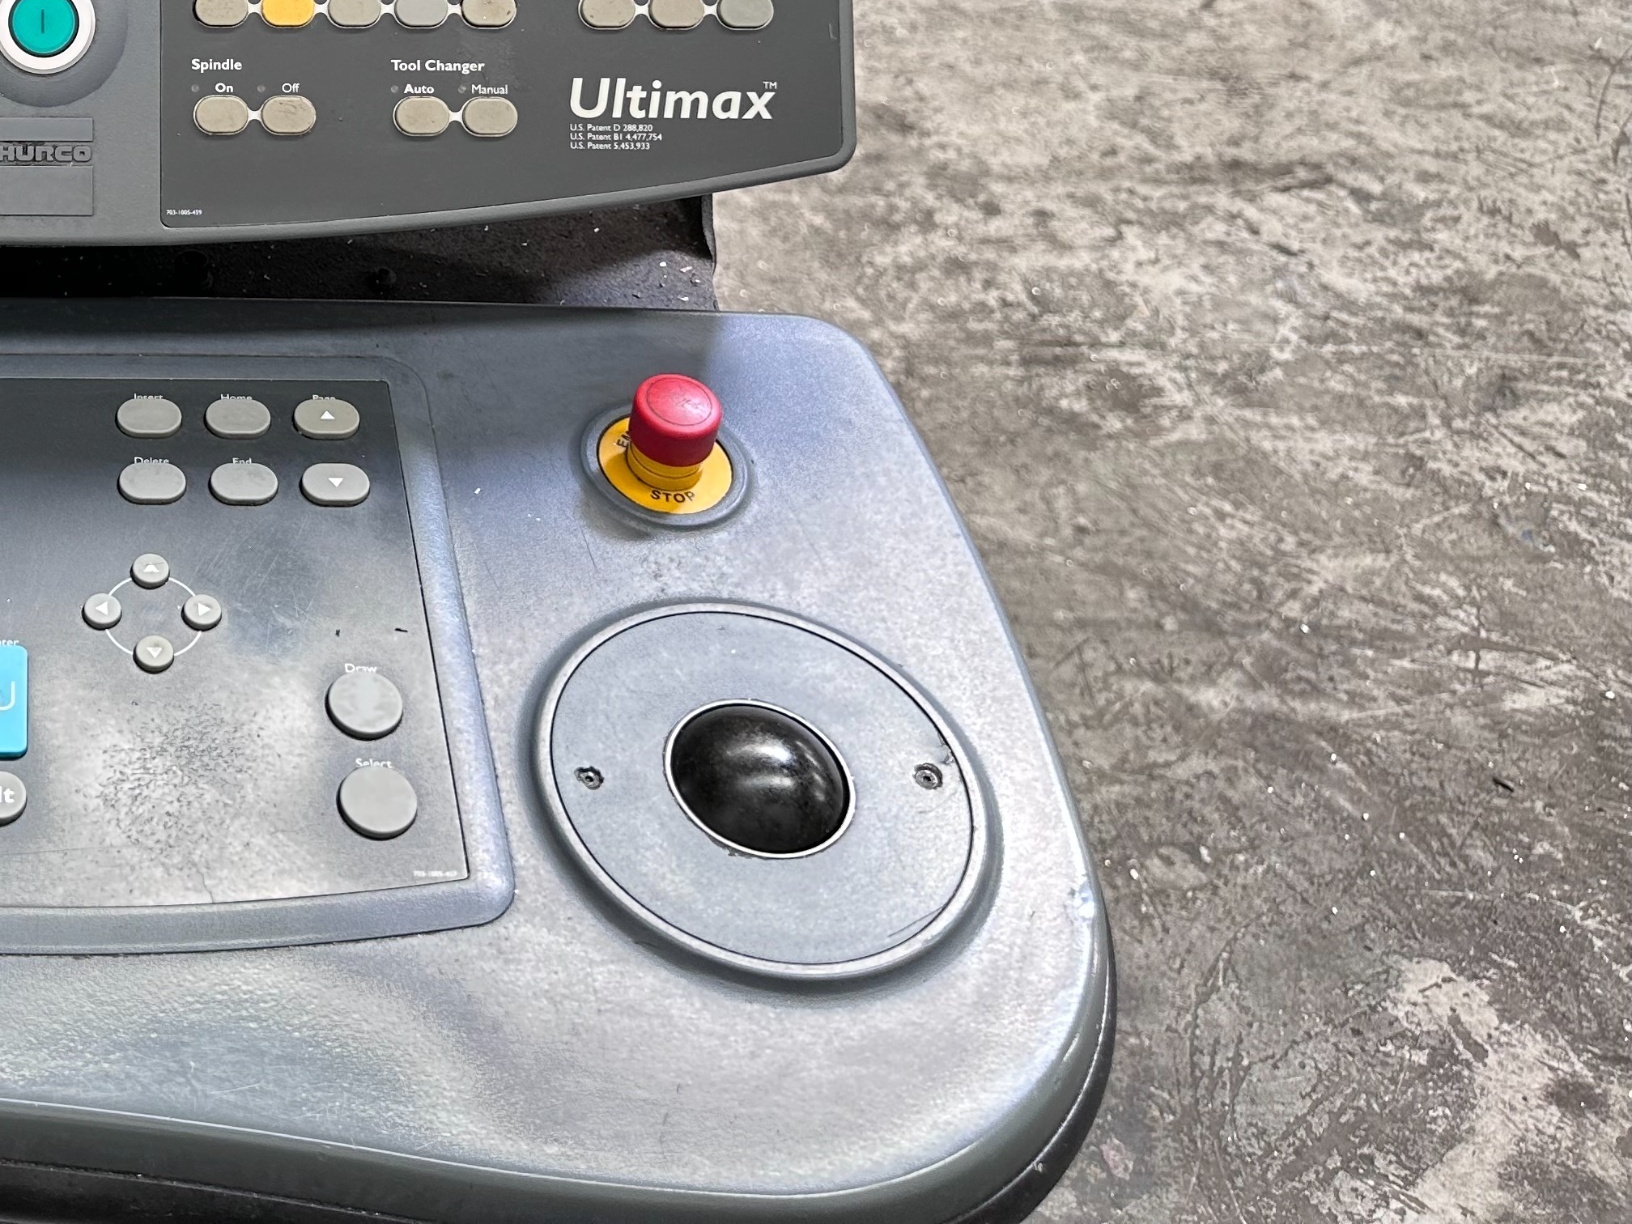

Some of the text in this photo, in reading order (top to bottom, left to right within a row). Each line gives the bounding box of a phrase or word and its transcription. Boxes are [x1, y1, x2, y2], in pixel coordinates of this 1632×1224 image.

[191, 58, 242, 73] Spindle
[390, 59, 485, 74] Tool Changer
[214, 82, 233, 92] On
[281, 82, 299, 92] Off
[403, 83, 434, 93] Auto
[471, 83, 508, 94] Manual
[570, 77, 776, 120] Ultimax
[569, 123, 585, 132] U.S.
[587, 123, 611, 132] Patent
[613, 123, 621, 132] D
[569, 132, 585, 141] U.S.
[587, 132, 612, 141] Patent
[625, 132, 663, 142] 4,477,754
[570, 141, 585, 150] U.S.
[587, 141, 612, 150] Patent
[650, 490, 696, 504] STOP
